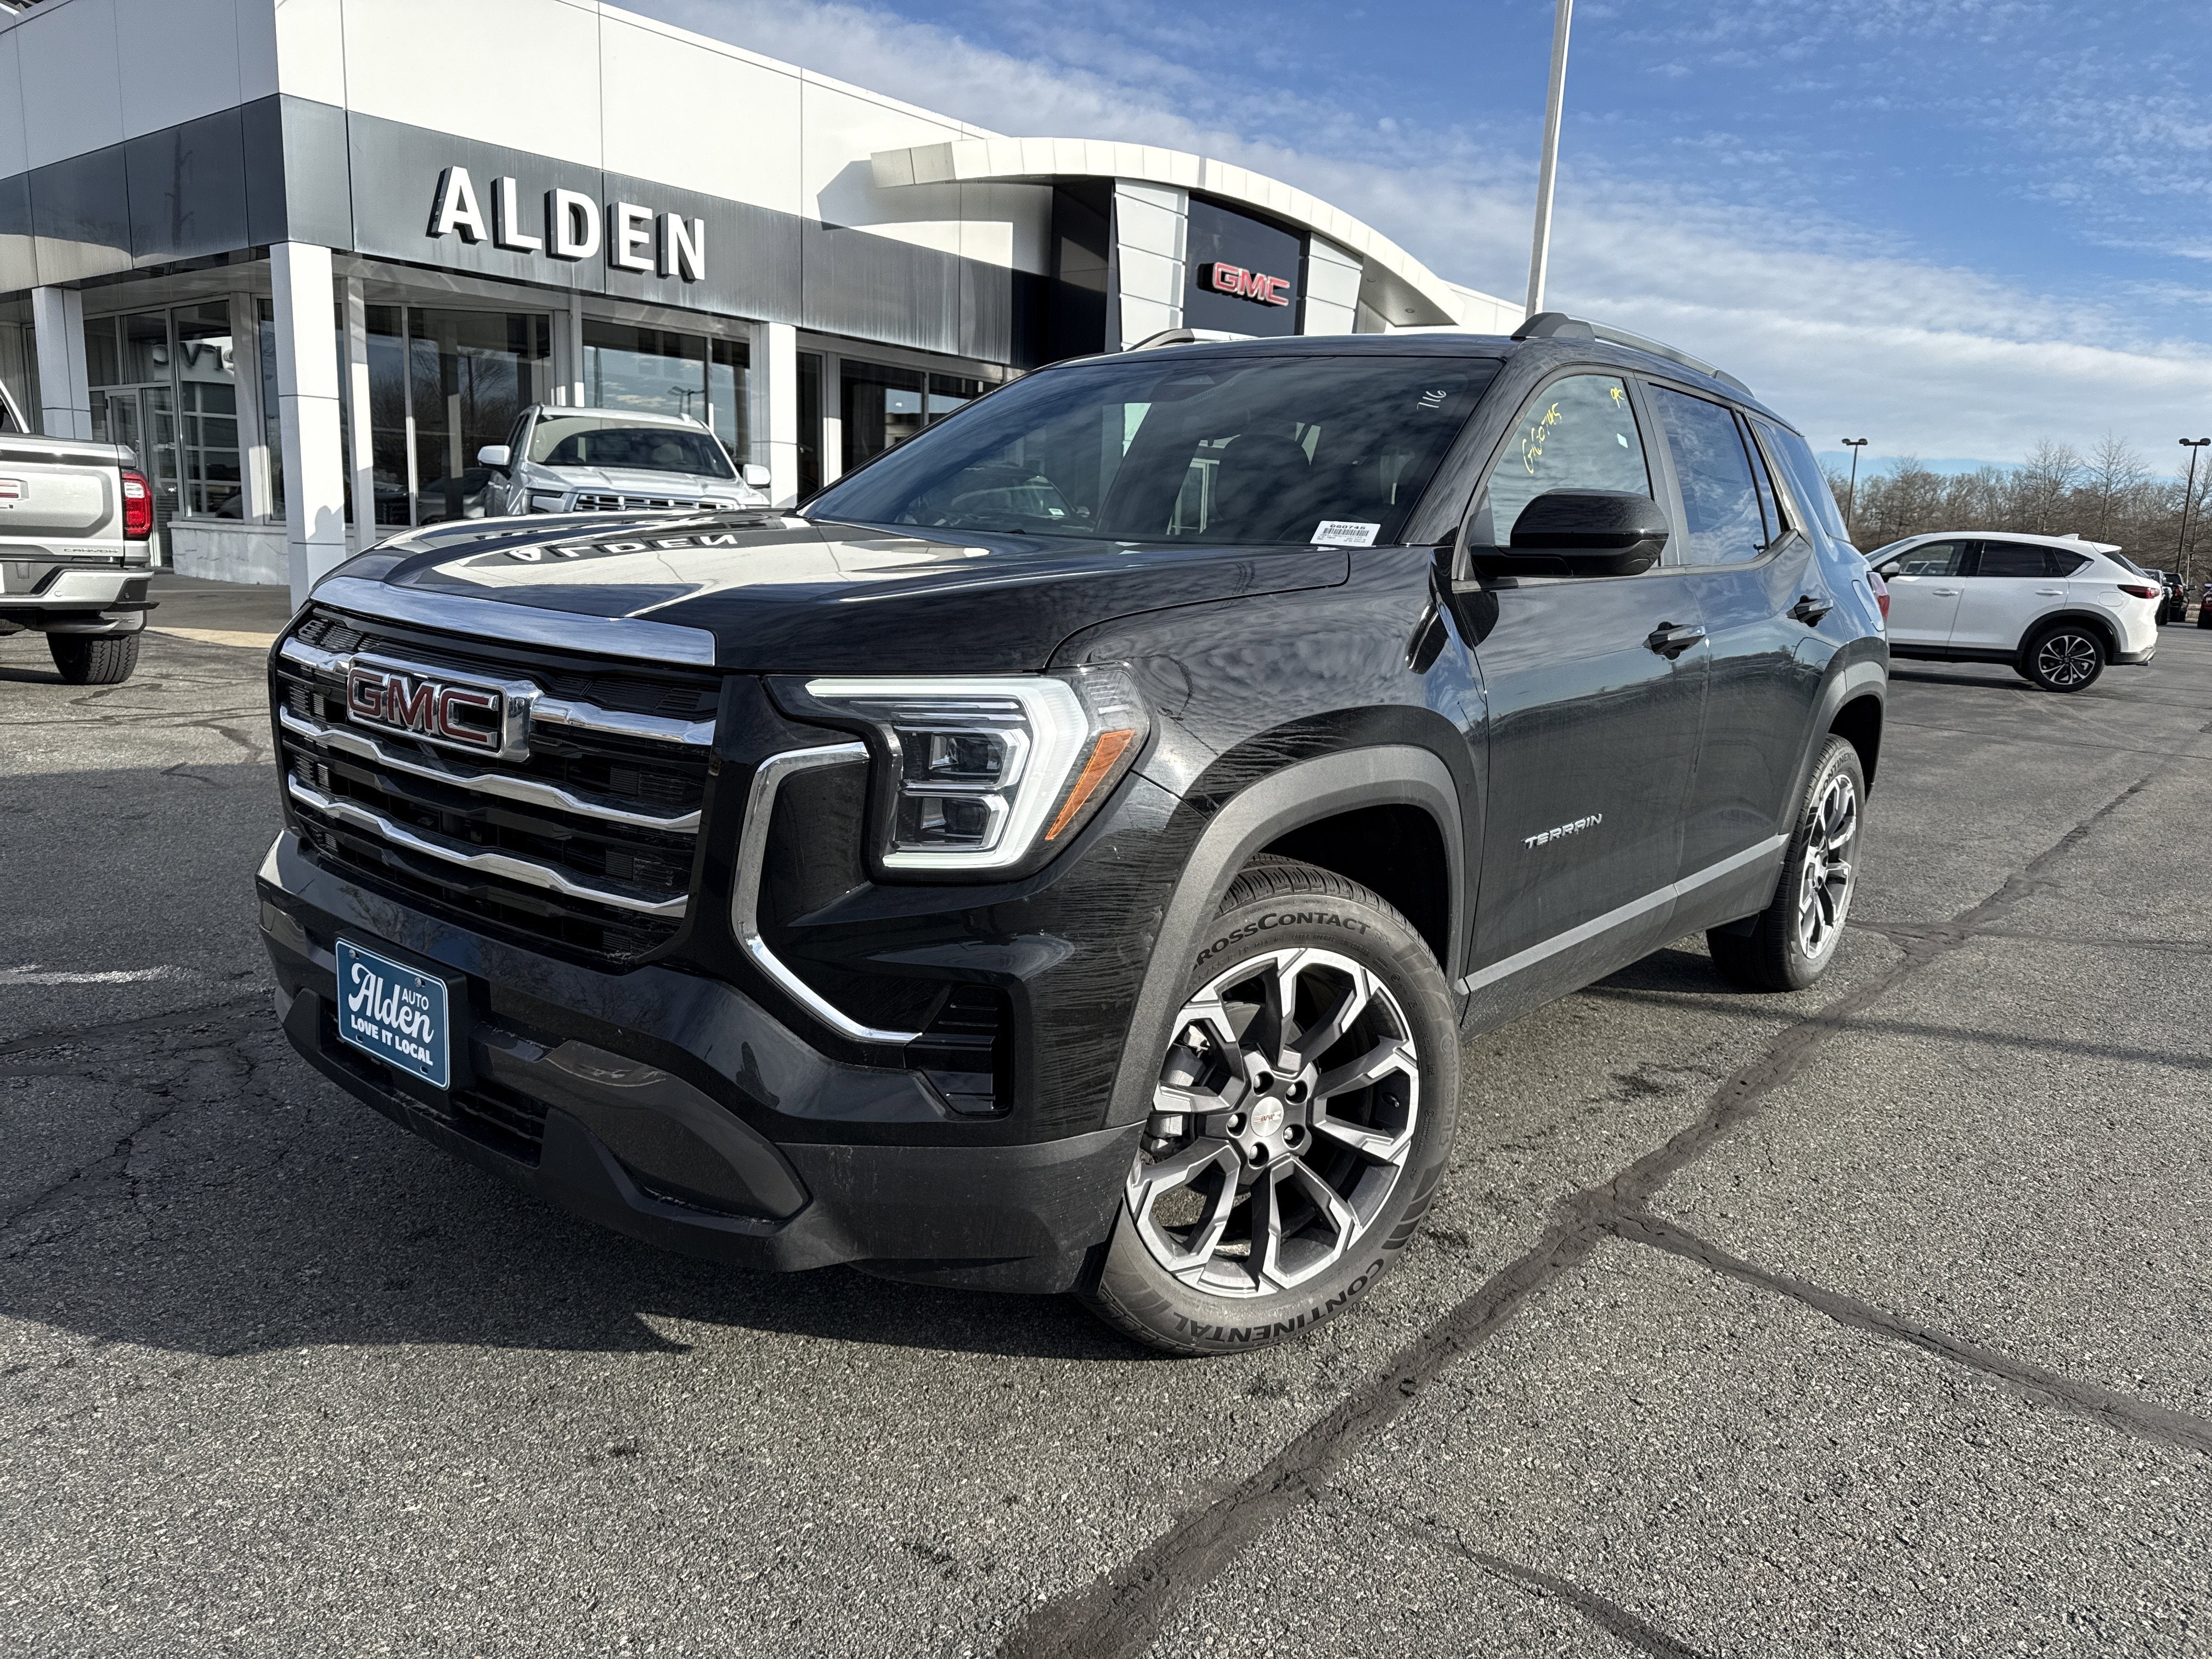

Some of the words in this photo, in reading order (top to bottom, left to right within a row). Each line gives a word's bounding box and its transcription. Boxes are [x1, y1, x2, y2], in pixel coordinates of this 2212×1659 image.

[431, 166, 705, 281] ALDEN
[1212, 262, 1290, 306] GMC
[1417, 390, 1447, 410] 716
[347, 666, 500, 748] GMC
[1819, 752, 1859, 802] CONTINENTA
[1523, 813, 1602, 849] TERRAIN
[1193, 912, 1371, 971] ROSSCONTACT
[348, 963, 435, 1043] Alden
[401, 988, 429, 1011] AUTO
[351, 1014, 379, 1040] LOVE
[381, 1029, 393, 1046] IT
[394, 1035, 433, 1066] LOCAL
[1173, 1258, 1384, 1343] CONTINENTAL
